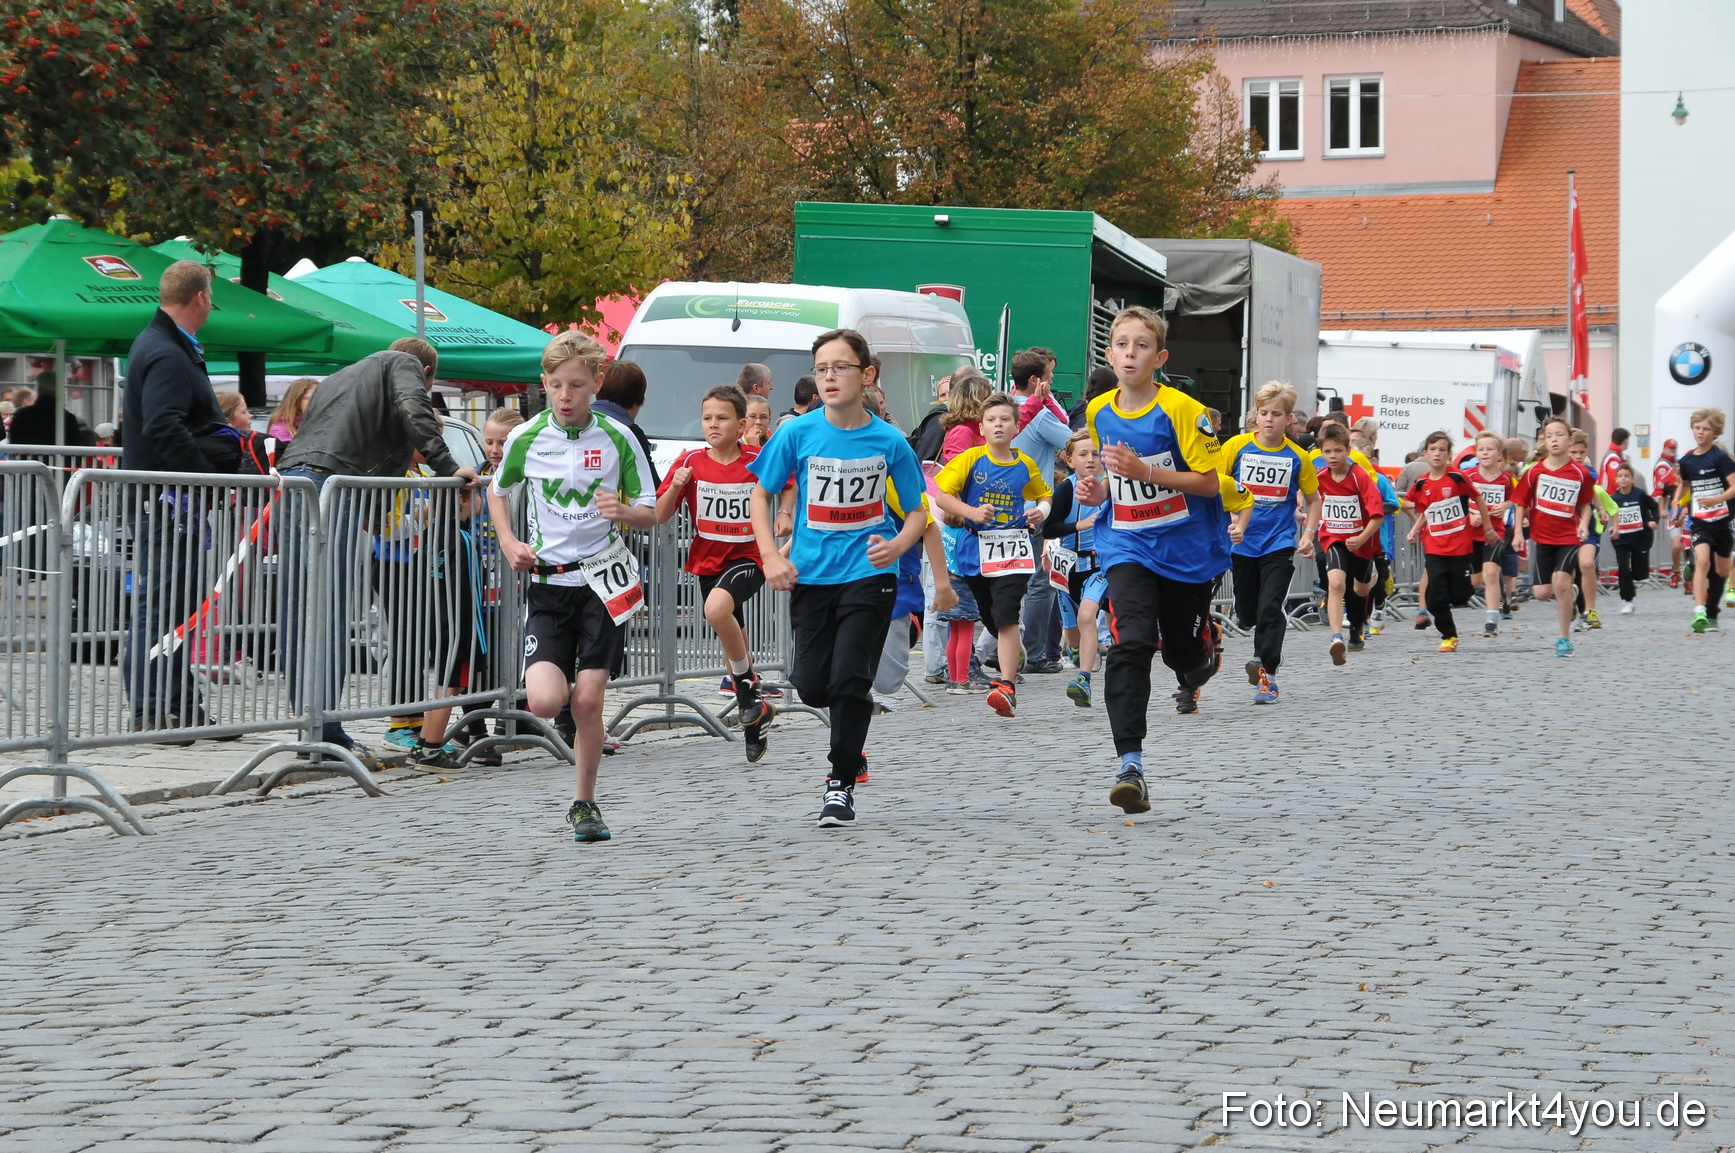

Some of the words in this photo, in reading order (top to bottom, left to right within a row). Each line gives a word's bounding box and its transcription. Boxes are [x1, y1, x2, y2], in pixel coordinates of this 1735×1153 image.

[736, 299, 796, 308] Europcar
[1673, 342, 1710, 358] BMW
[1380, 394, 1445, 406] Bayerisches
[1380, 407, 1411, 418] Rotes
[1379, 420, 1410, 431] Kreuz
[1205, 440, 1220, 450] PAR
[809, 463, 837, 473] PARTL
[837, 465, 875, 474] Neumarkt
[1246, 465, 1287, 485] 7597
[698, 486, 718, 495] PARTL
[719, 487, 748, 496] Neumarkt
[816, 474, 880, 504] 7127
[1542, 484, 1576, 503] 7037
[703, 496, 751, 520] 7050
[1130, 505, 1161, 519] David
[1324, 504, 1358, 519] 7062
[1428, 505, 1461, 523] 7120
[562, 511, 602, 521] ENERGI
[829, 510, 866, 521] Maxim
[715, 524, 739, 534] Kilian
[985, 541, 1029, 560] 7175
[582, 558, 609, 573] PARTL
[593, 554, 638, 595] 701
